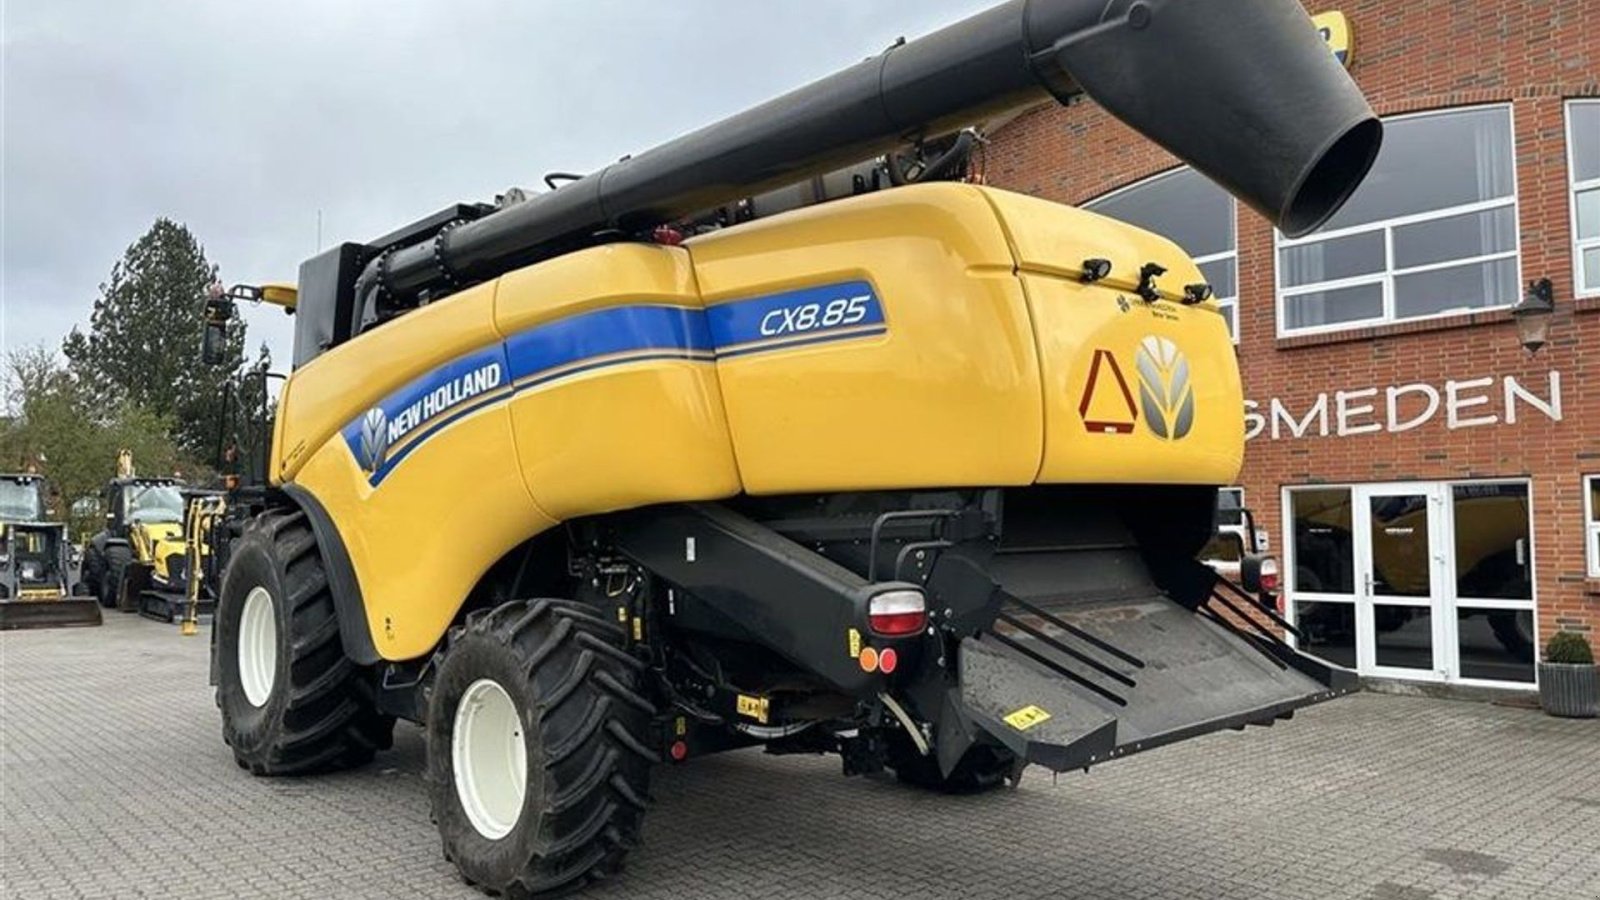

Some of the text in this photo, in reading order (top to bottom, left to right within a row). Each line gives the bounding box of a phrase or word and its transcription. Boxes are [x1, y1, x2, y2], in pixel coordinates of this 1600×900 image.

[761, 295, 871, 336] CX8.85
[388, 362, 500, 445] NEW HOLLAND
